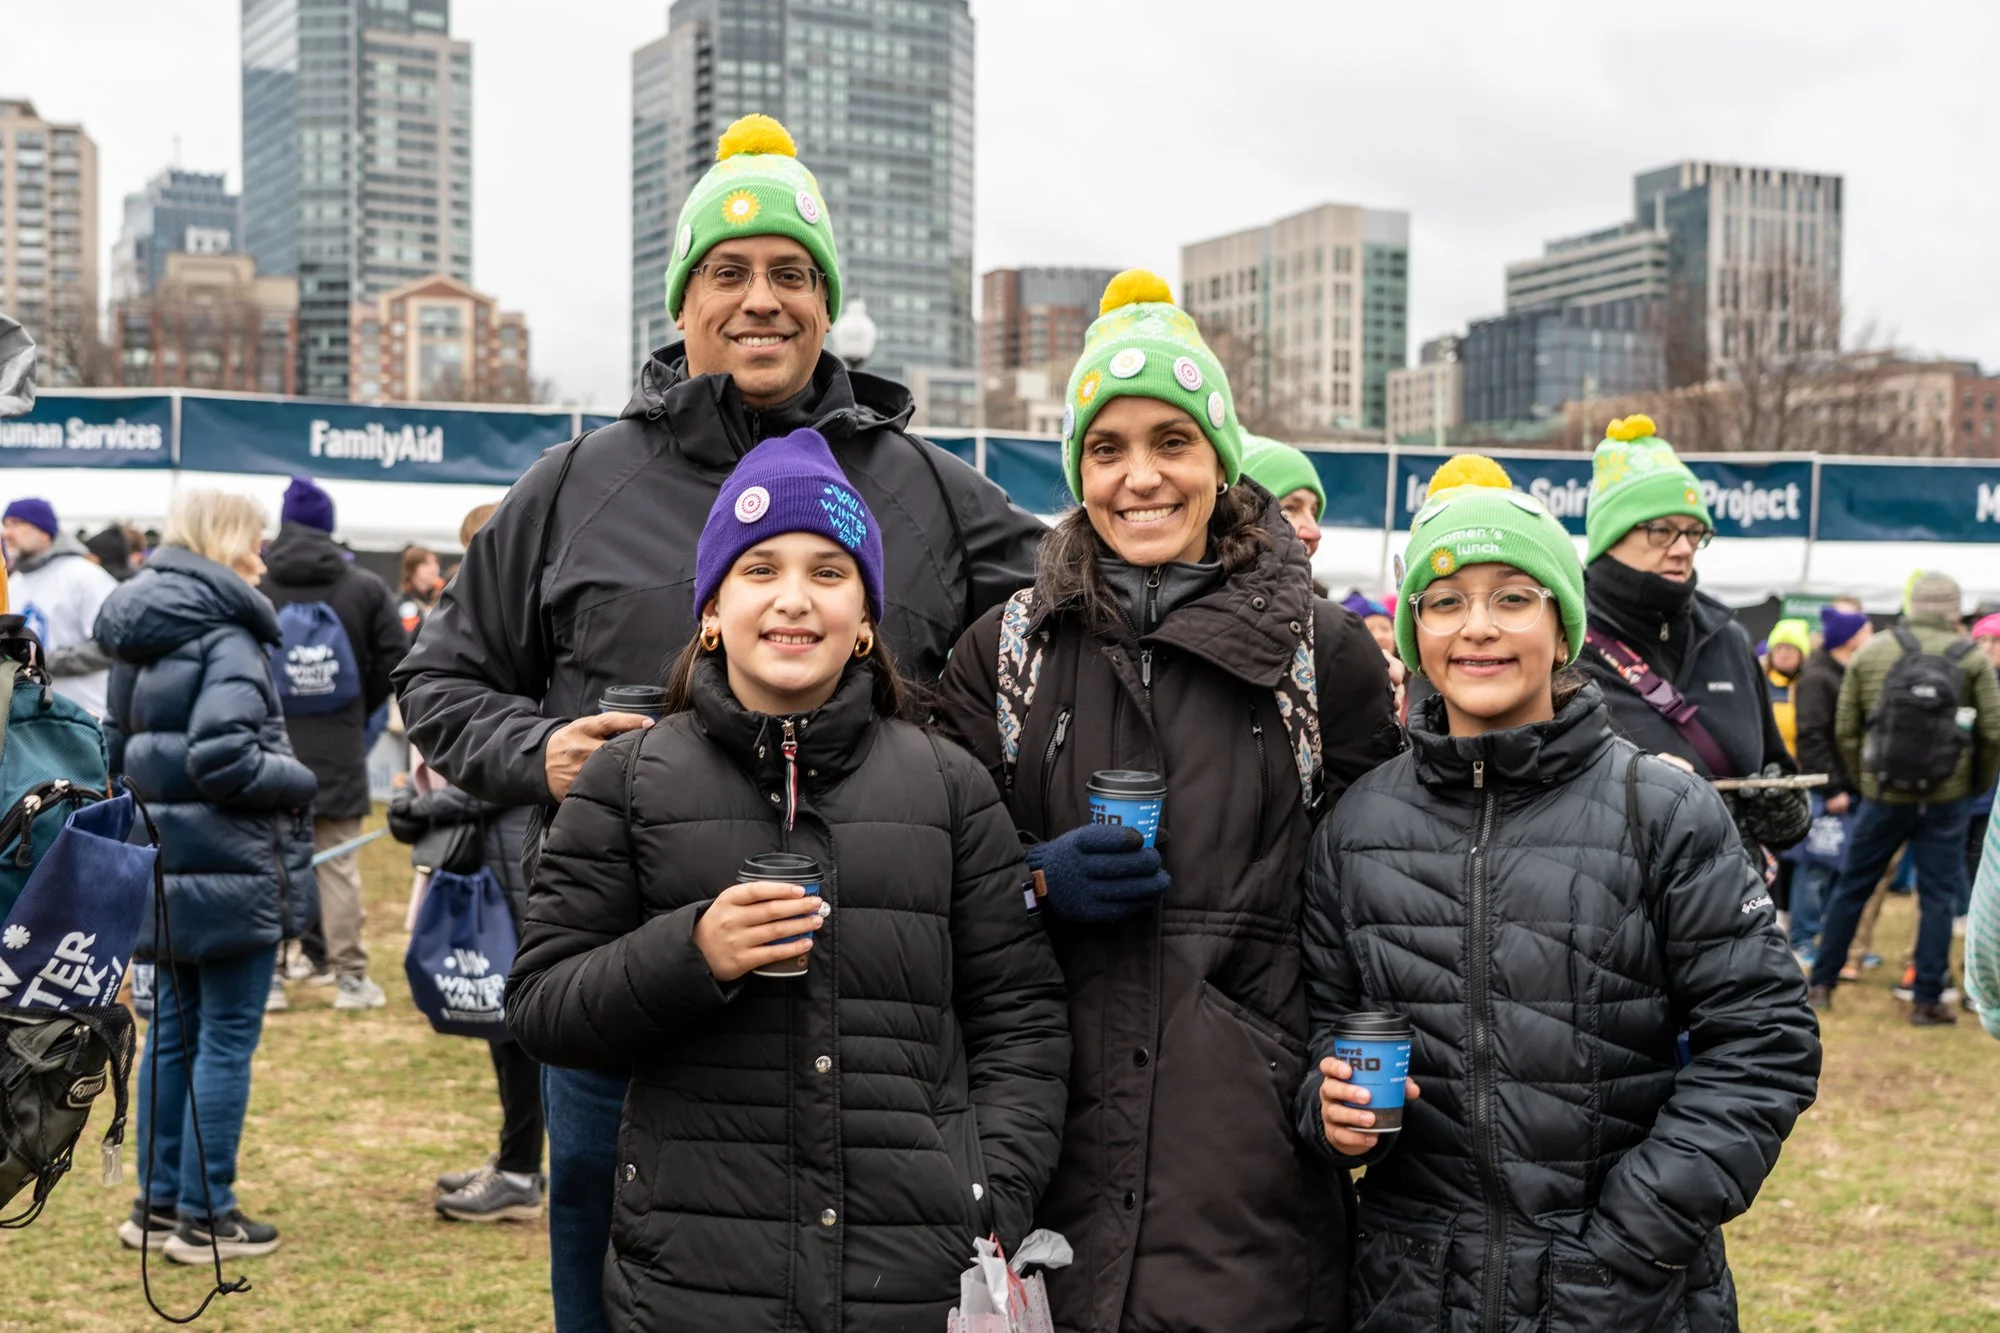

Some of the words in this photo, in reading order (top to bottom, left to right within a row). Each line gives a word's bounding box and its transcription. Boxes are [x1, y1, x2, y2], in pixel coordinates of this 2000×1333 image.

[0, 422, 63, 448] uman
[65, 416, 162, 450] Services
[310, 419, 444, 468] FamilyAid
[820, 498, 868, 540] WINTER
[1529, 477, 1594, 517] Spir
[1700, 480, 1800, 528] Project
[829, 513, 863, 549] WALK
[1456, 541, 1501, 556] lunch
[19, 931, 97, 1008] TER
[434, 972, 506, 997] WINTER
[444, 990, 502, 1011] WALK
